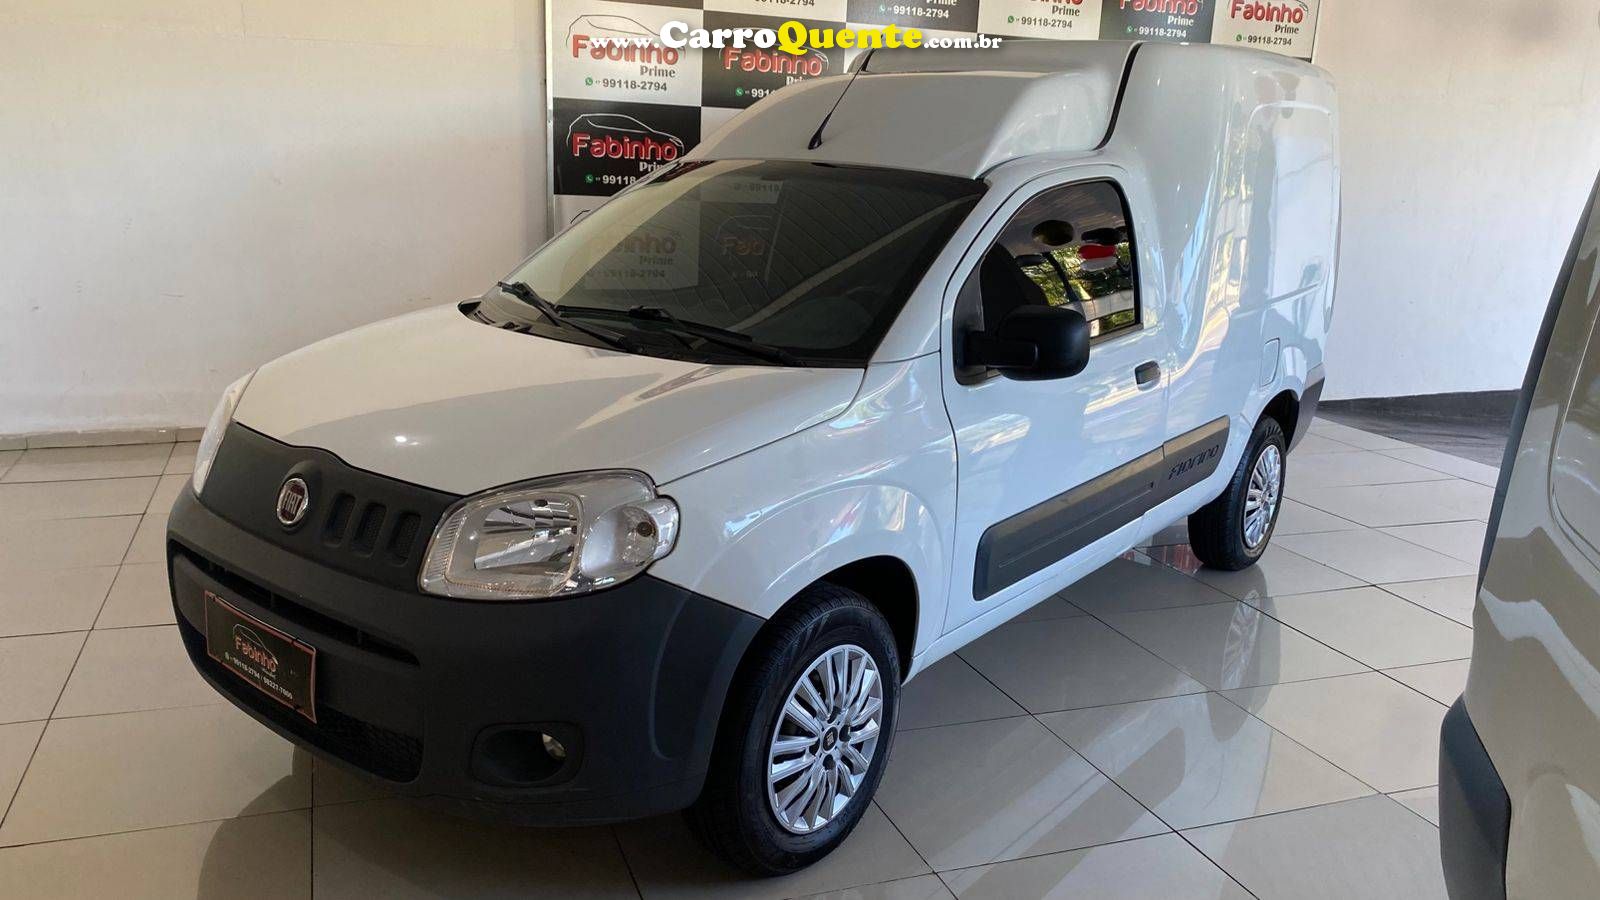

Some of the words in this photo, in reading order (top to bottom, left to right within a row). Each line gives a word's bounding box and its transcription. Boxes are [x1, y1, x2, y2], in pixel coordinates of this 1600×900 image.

[893, 5, 949, 18] 99118-2794
[1051, 5, 1080, 16] Prime
[1231, 0, 1304, 23] Fabinho
[1021, 16, 1073, 28] 99118-2794
[1167, 15, 1194, 26] Prime
[1138, 26, 1187, 38] 99118-2794
[1274, 24, 1299, 34] Prime
[1248, 35, 1292, 45] 99118-2794
[723, 46, 822, 76] Fabinho
[640, 65, 676, 78] Prime
[602, 78, 667, 91] 99118-2794
[572, 132, 678, 161] Fabinho
[282, 491, 302, 514] FIAT
